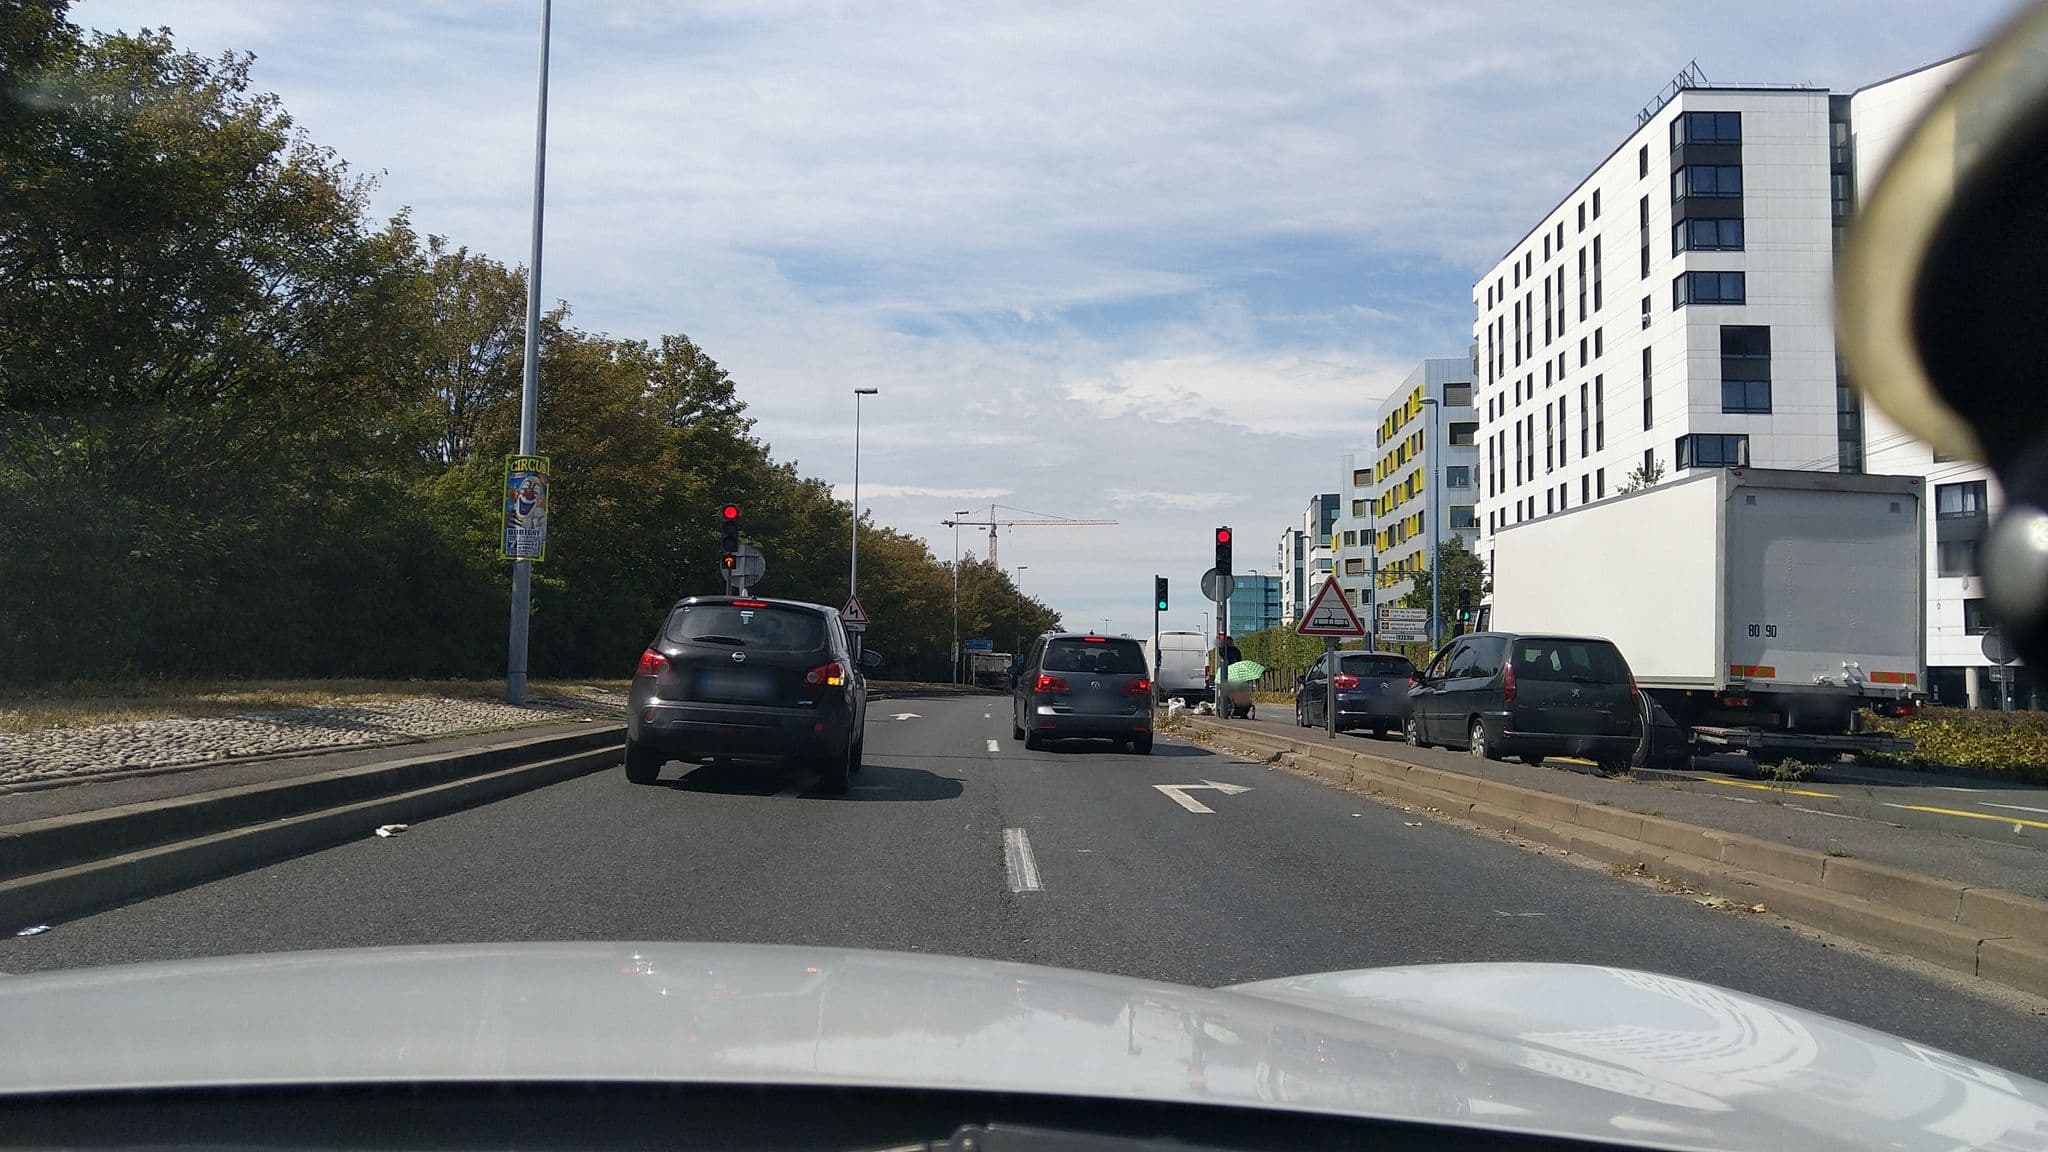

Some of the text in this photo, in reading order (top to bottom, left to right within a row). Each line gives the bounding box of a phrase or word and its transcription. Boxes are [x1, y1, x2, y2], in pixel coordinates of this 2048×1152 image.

[510, 458, 547, 474] CIRCUS
[1748, 624, 1777, 638] 80 90
